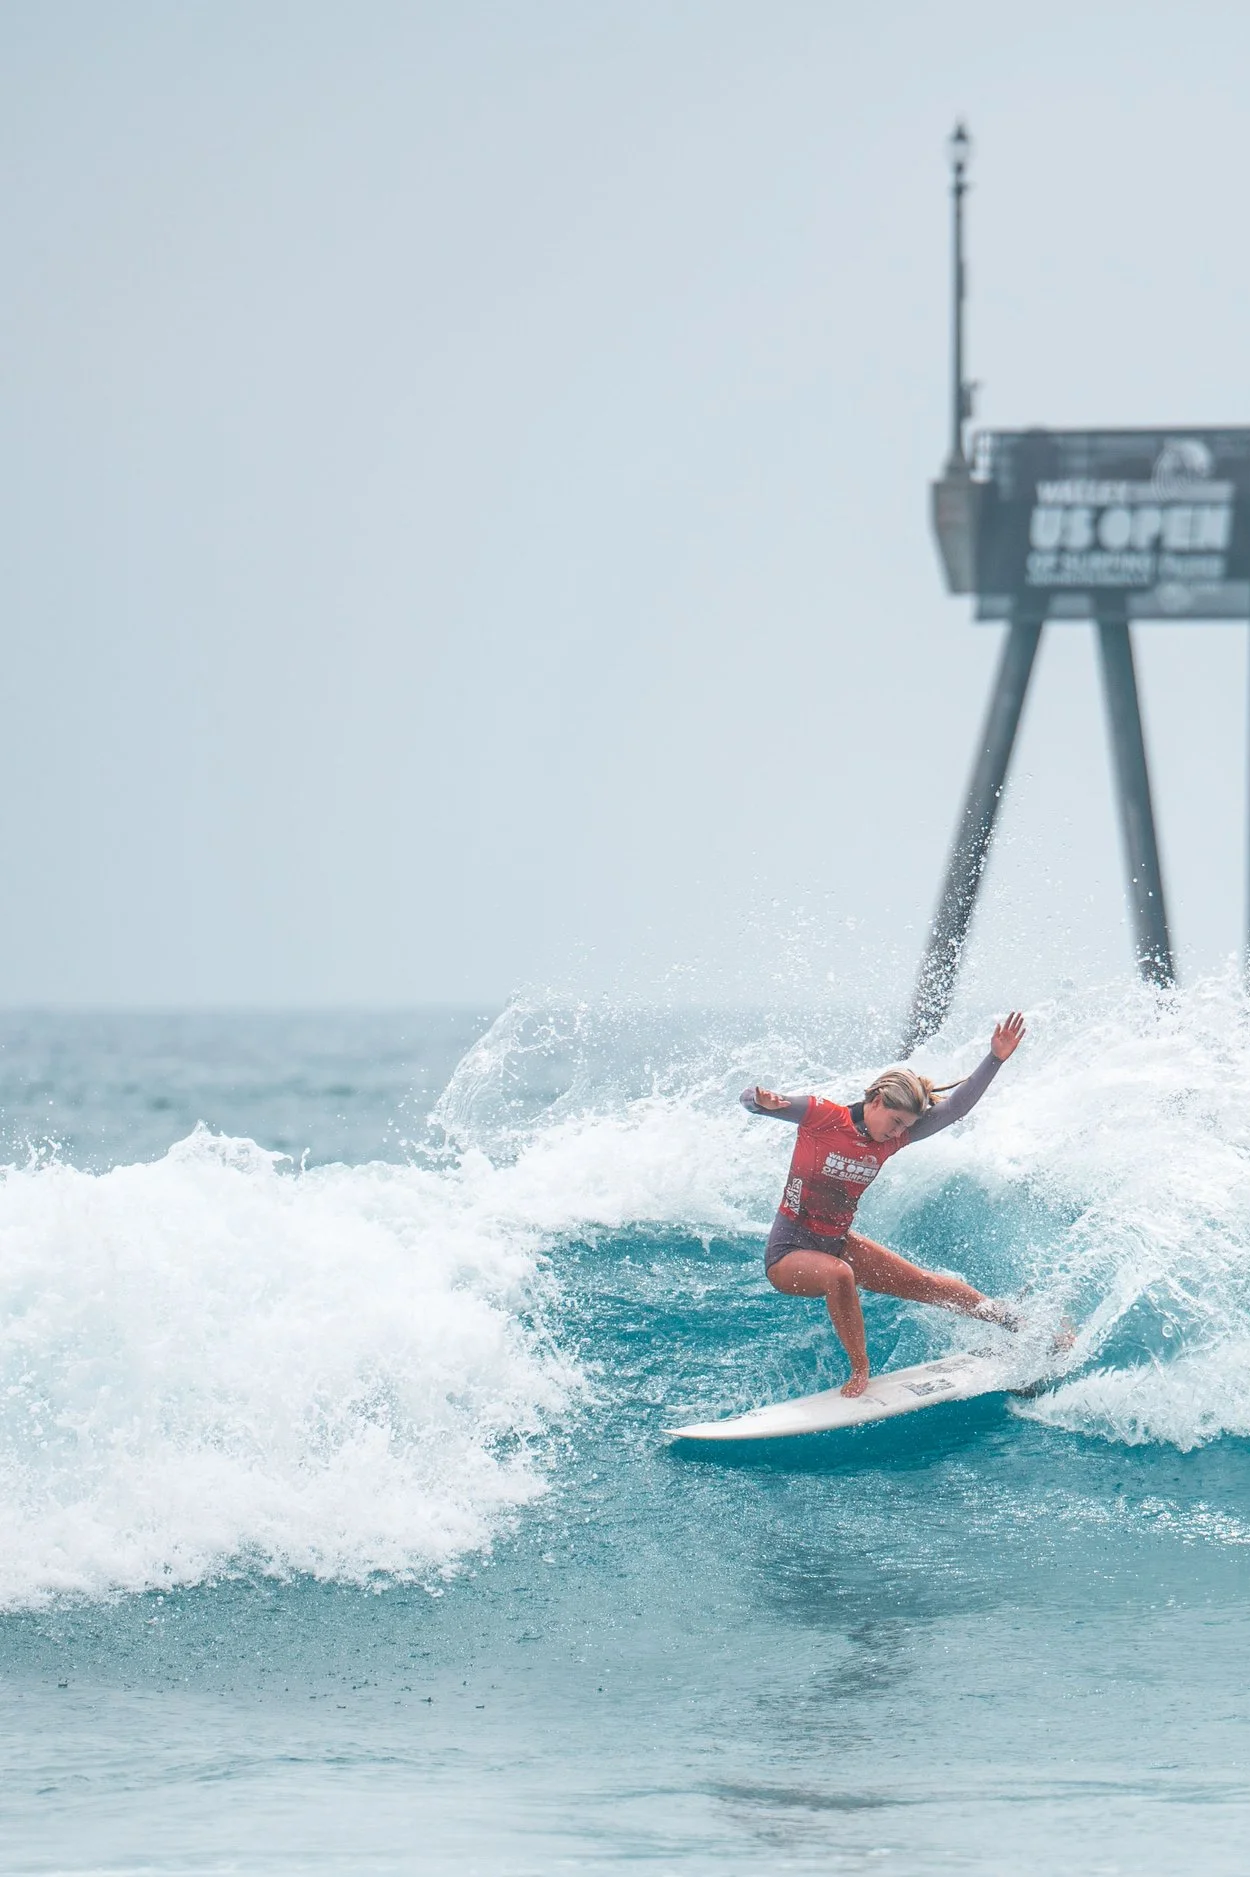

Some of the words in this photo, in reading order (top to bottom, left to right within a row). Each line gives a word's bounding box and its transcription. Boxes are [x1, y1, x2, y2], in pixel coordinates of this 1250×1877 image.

[1029, 505, 1092, 550] US
[1098, 505, 1231, 550] OPEN
[826, 1157, 845, 1170] US
[823, 1166, 838, 1175] OF
[839, 1171, 874, 1183] SURFIN
